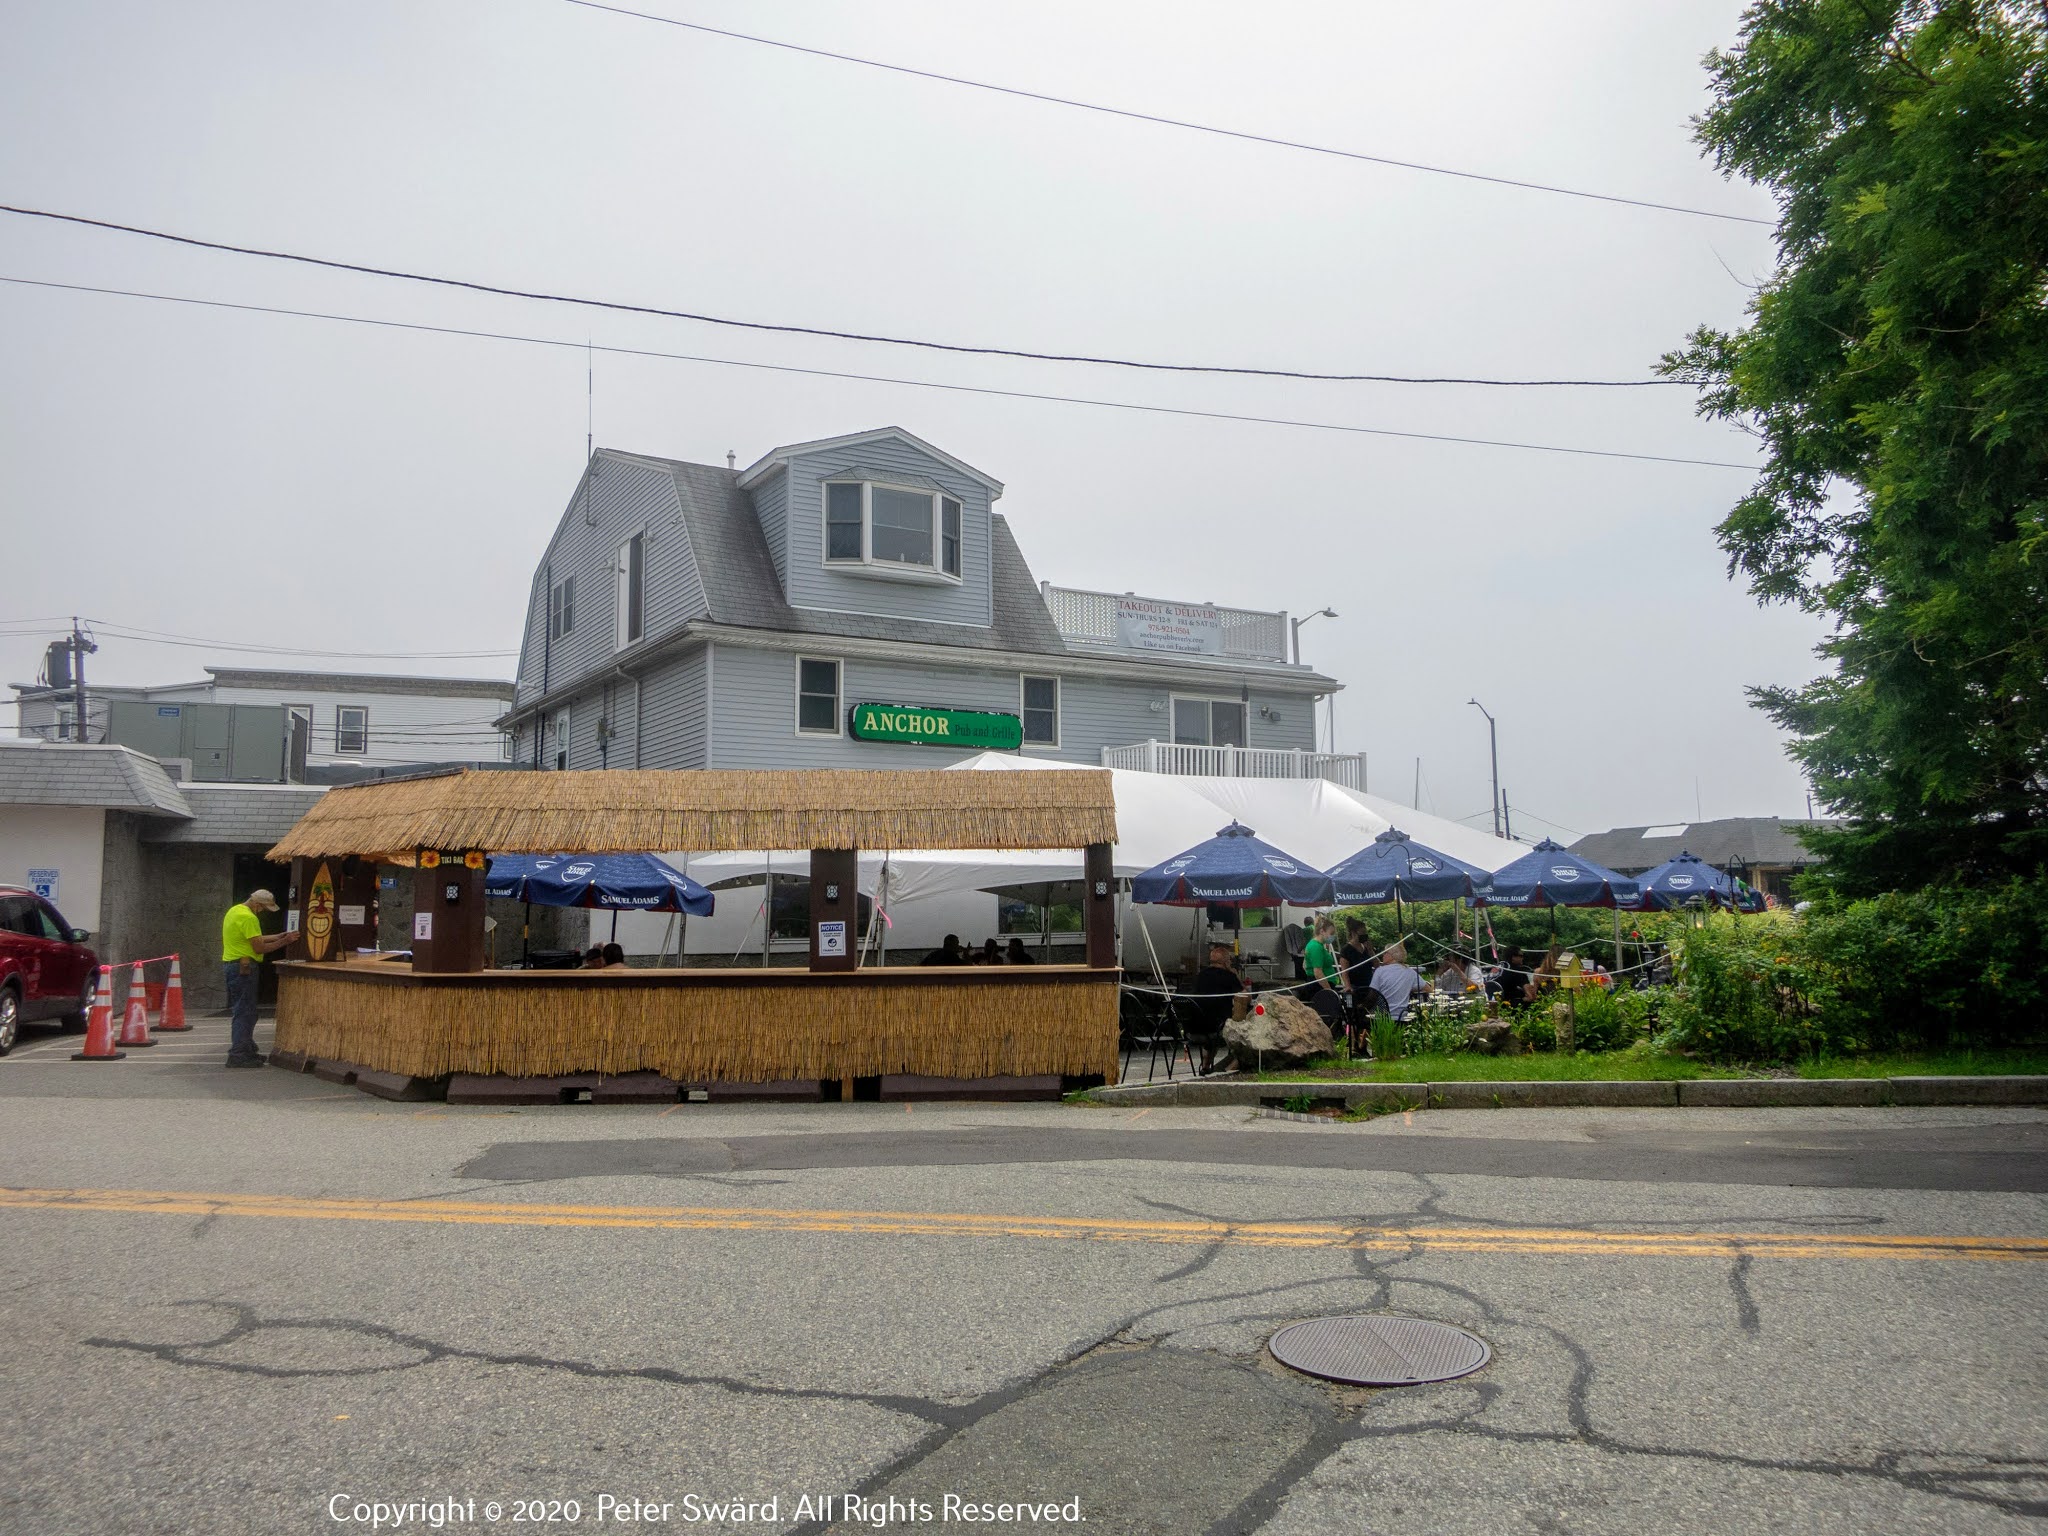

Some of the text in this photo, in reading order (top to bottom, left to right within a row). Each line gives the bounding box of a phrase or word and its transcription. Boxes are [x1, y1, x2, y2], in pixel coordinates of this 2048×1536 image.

[1118, 600, 1162, 614] TAKEOUT
[1165, 606, 1173, 615] &
[1117, 611, 1157, 621] SUN-THURS
[1176, 644, 1201, 652] Facebook
[863, 712, 1015, 740] ANCHOR Pub and Grille
[441, 856, 464, 864] TIKI BAR
[1192, 886, 1253, 897] SAMUEL ADAMS
[1336, 890, 1386, 900] SAMUEL ADAMS
[601, 894, 659, 904] SAMUEL ADAMS
